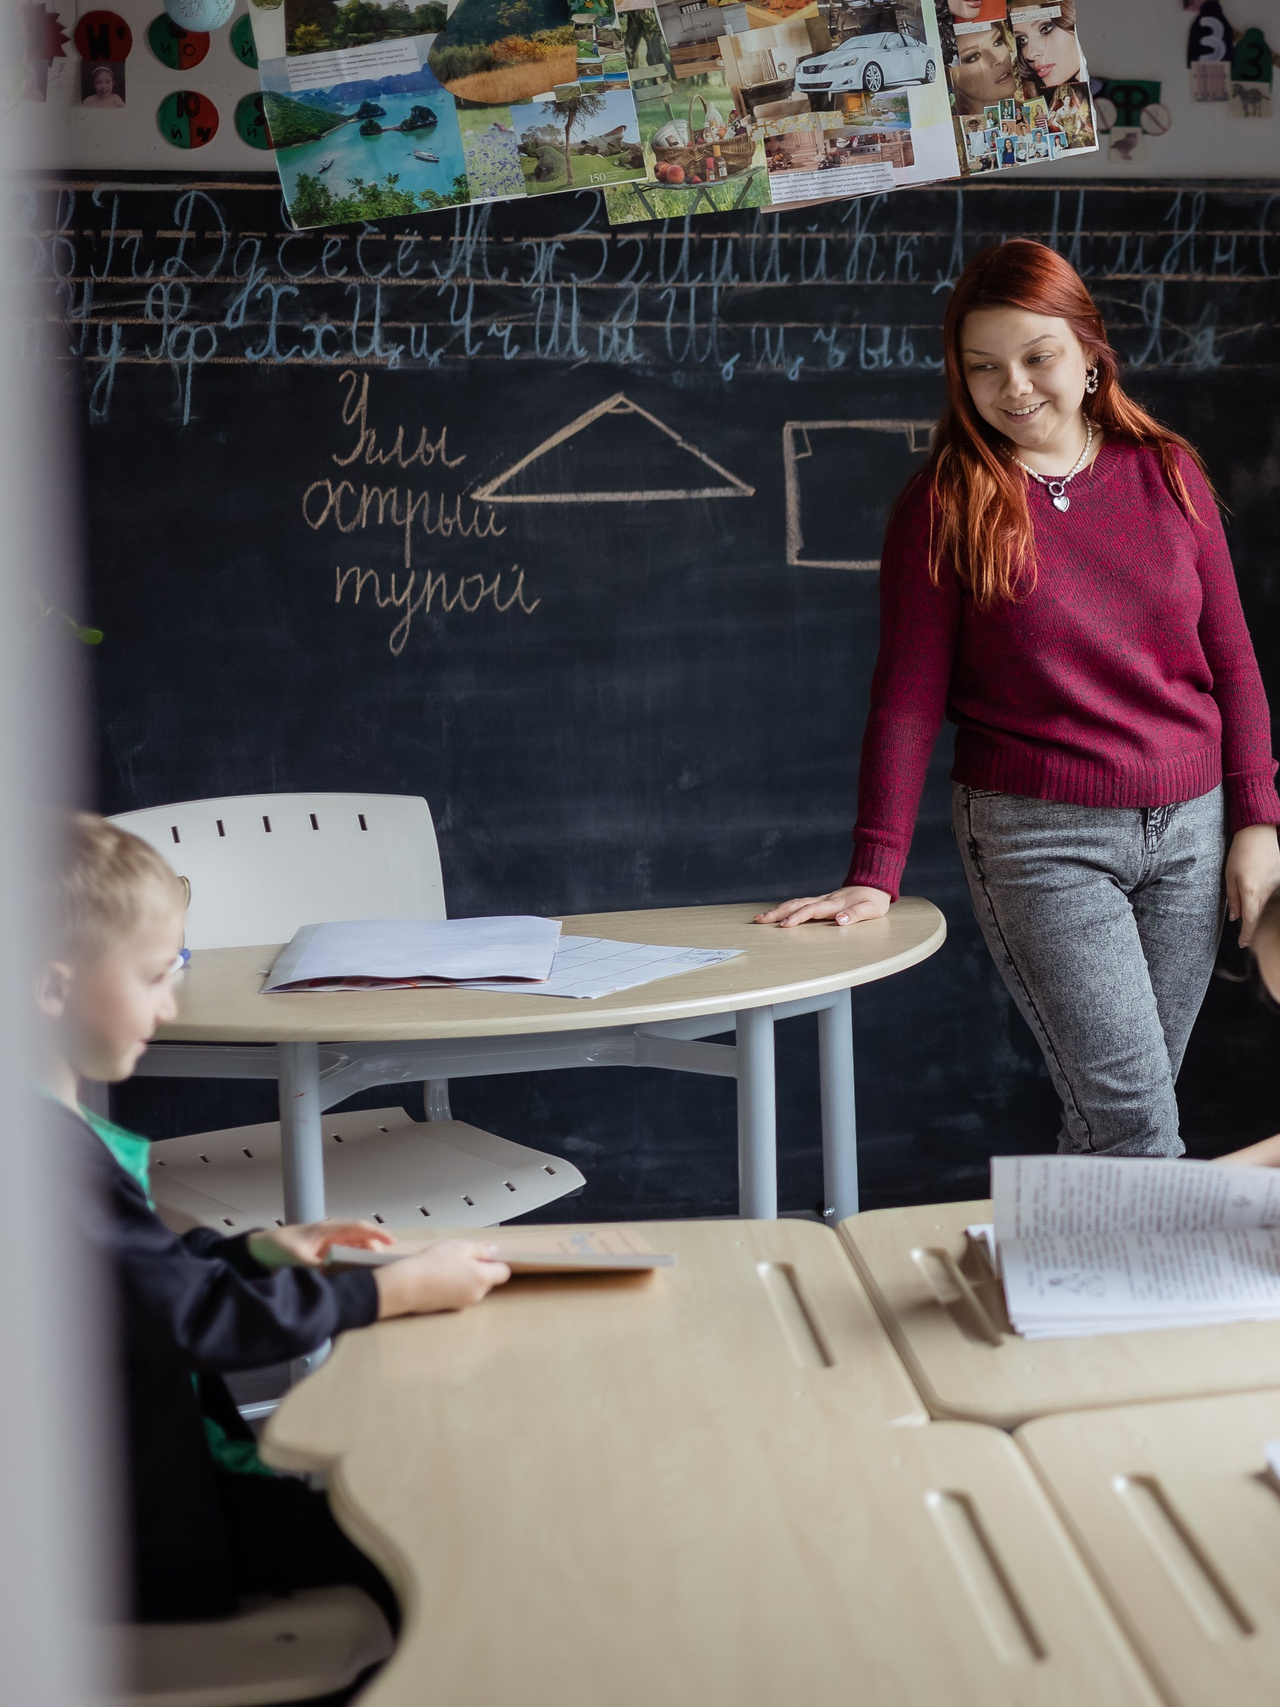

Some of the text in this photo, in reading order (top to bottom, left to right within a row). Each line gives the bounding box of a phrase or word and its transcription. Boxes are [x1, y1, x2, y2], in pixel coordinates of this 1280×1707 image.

[590, 173, 606, 183] 150
[333, 370, 467, 467] Углы
[335, 564, 541, 657] тупой
